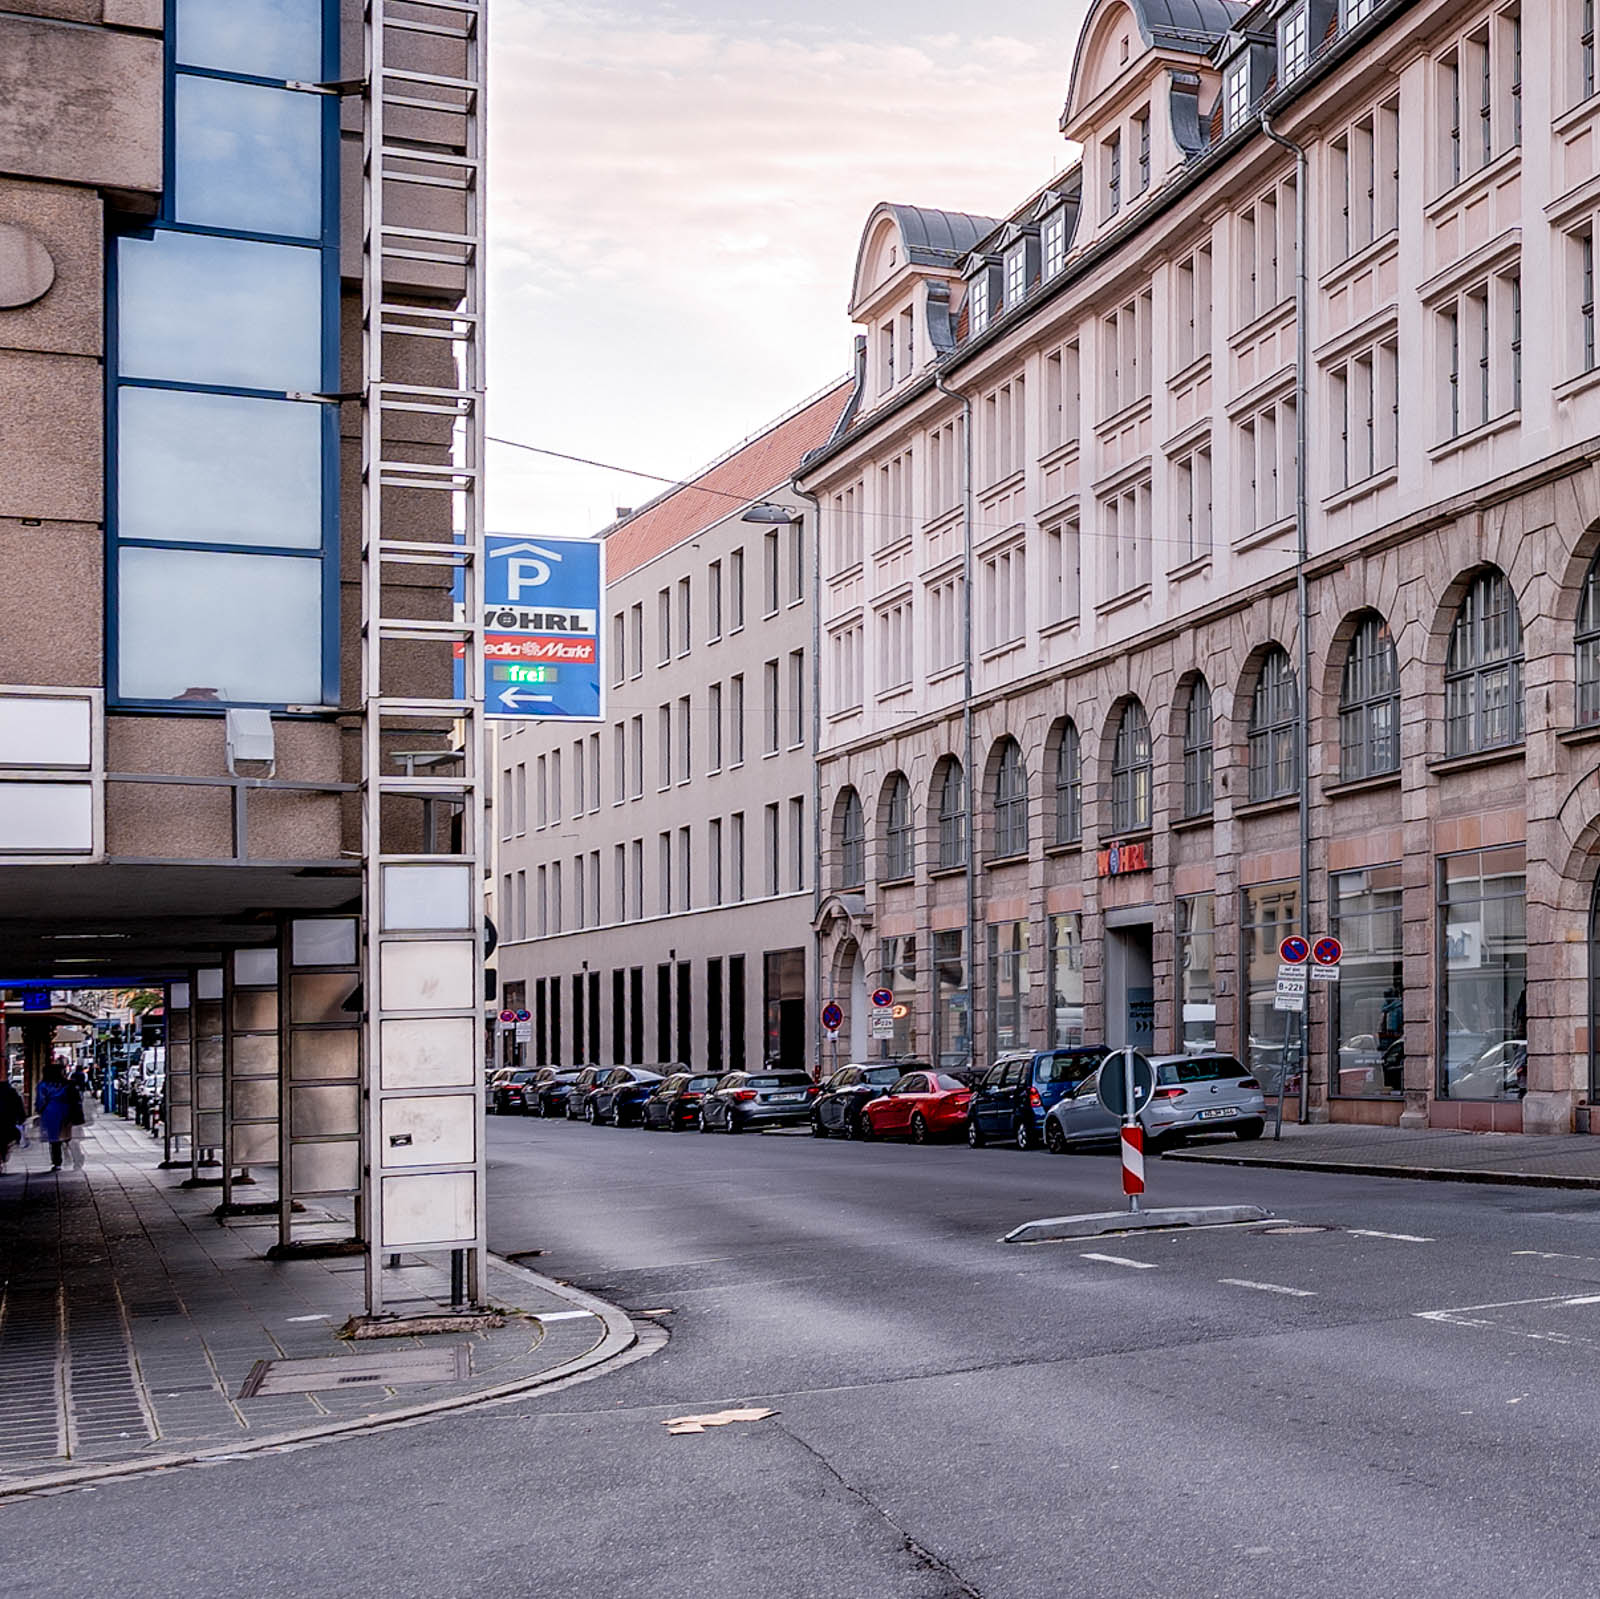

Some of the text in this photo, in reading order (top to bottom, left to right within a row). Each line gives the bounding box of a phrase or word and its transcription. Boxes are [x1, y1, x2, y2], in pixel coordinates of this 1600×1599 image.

[507, 557, 551, 601] P
[508, 664, 546, 683] frei
[1096, 841, 1148, 878] WÖHRL
